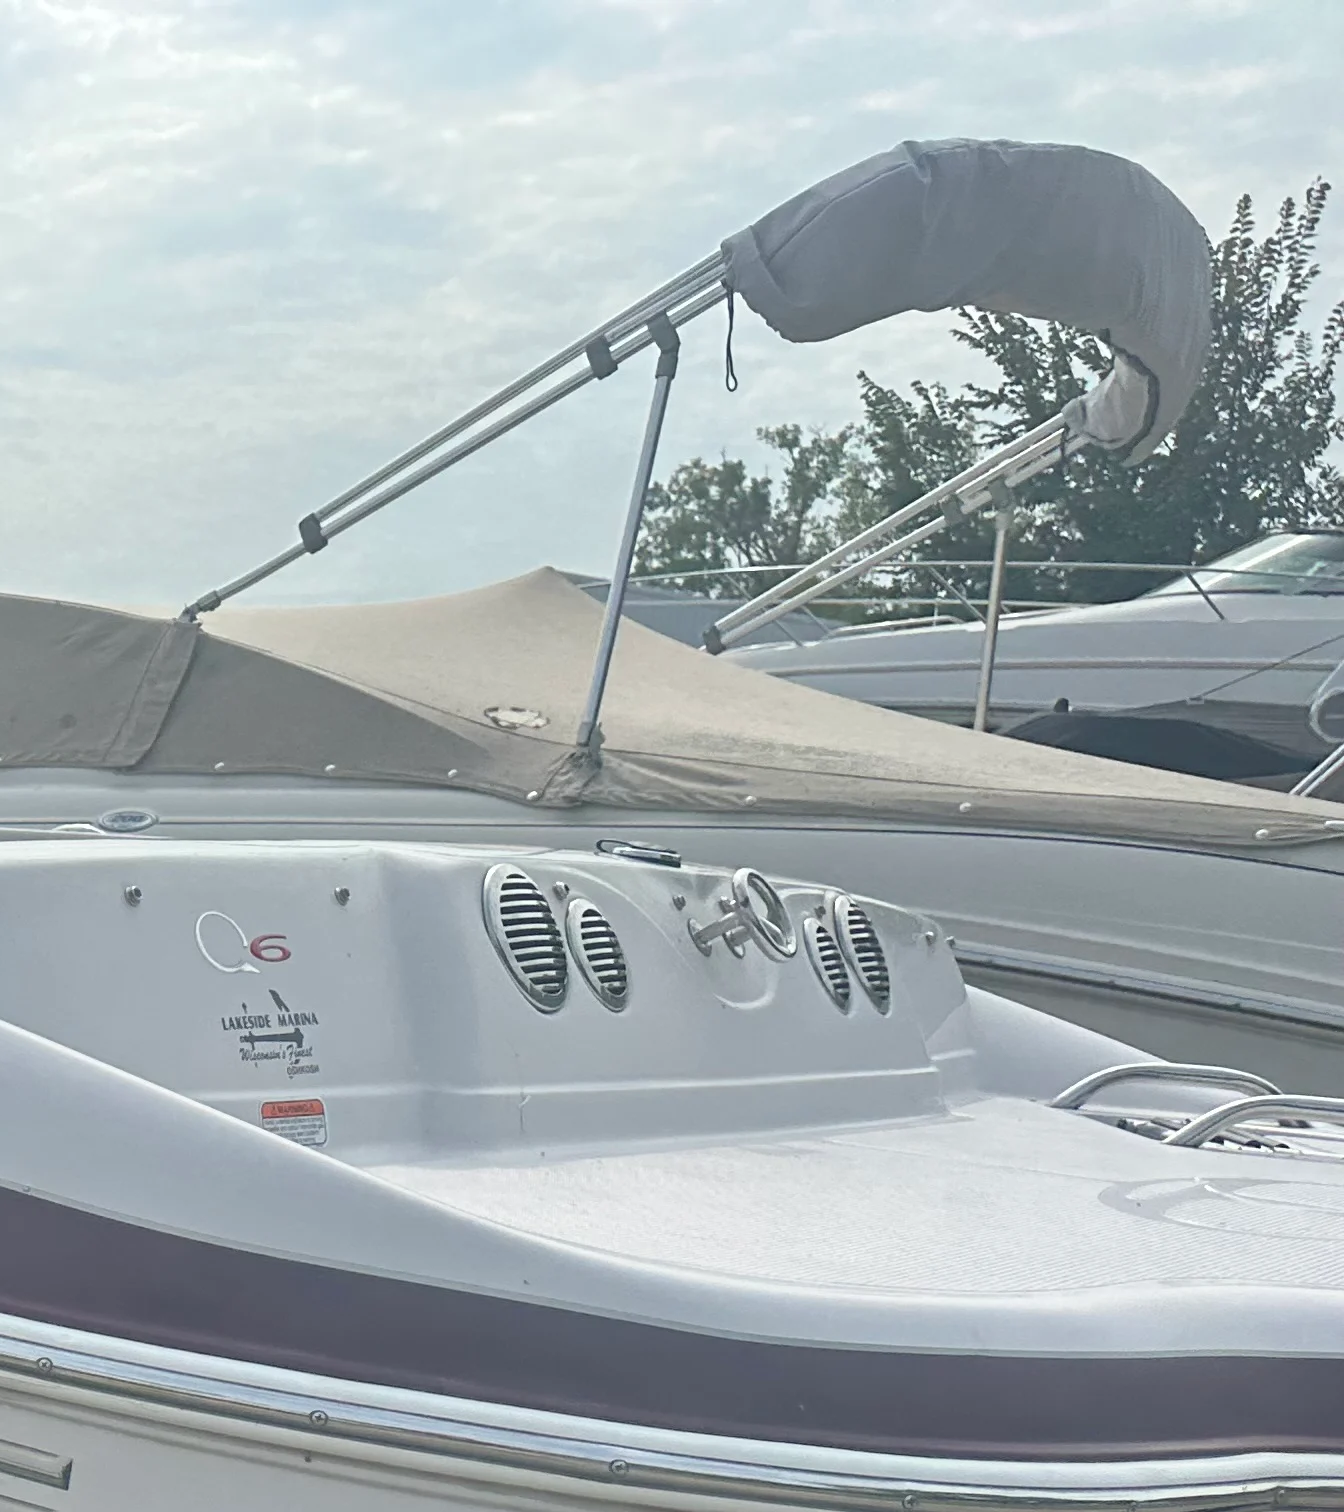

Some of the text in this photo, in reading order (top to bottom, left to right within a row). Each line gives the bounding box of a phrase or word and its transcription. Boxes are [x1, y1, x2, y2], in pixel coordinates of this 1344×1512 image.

[195, 910, 291, 974] Q6
[220, 1011, 320, 1031] LAKESIDE MARINA
